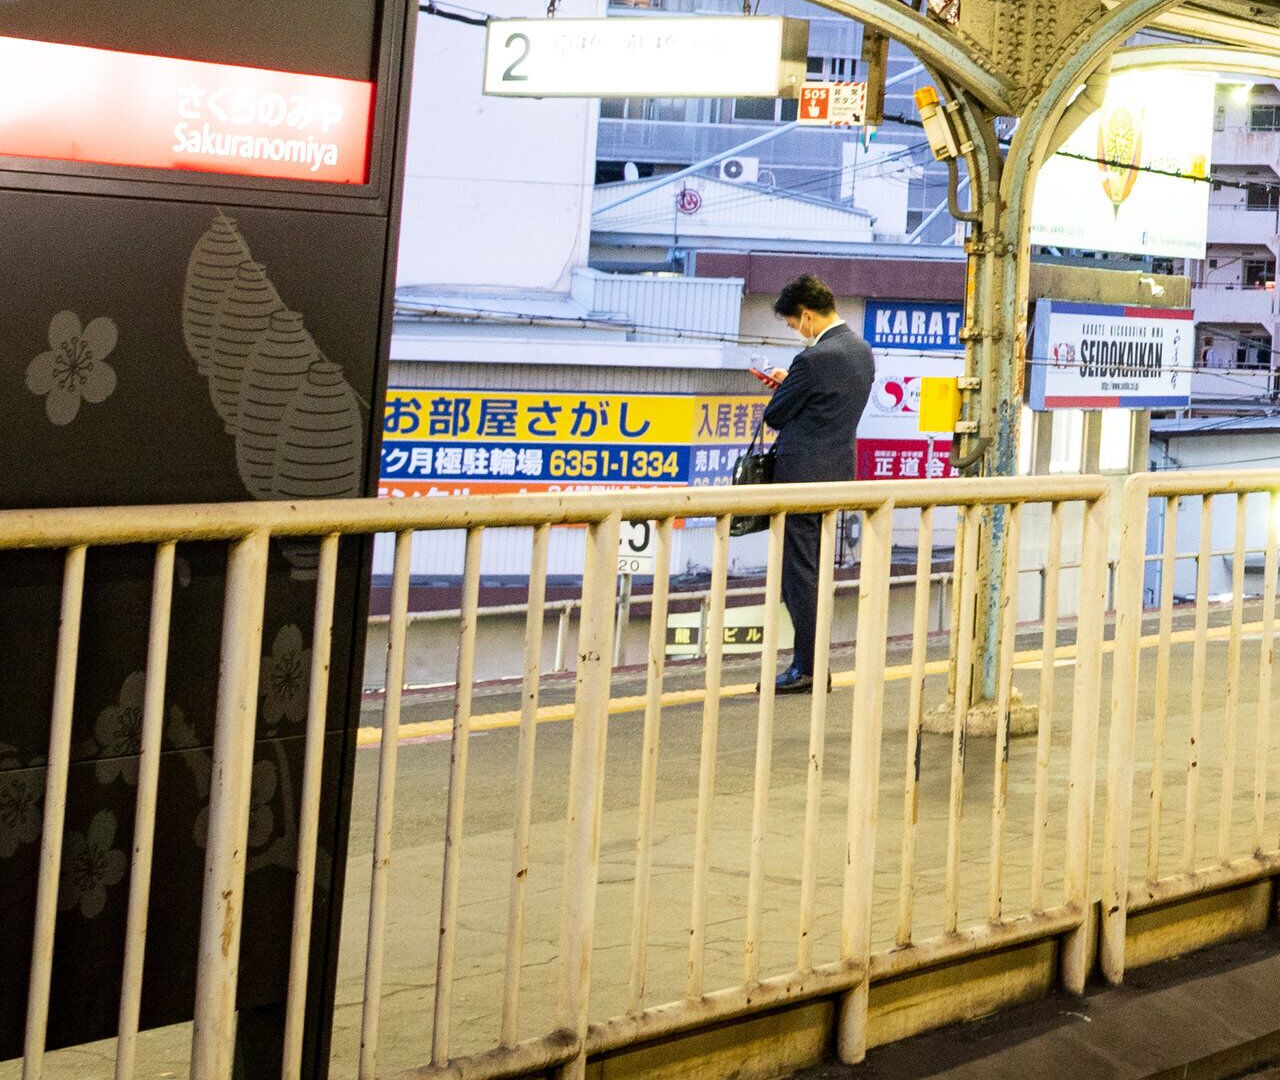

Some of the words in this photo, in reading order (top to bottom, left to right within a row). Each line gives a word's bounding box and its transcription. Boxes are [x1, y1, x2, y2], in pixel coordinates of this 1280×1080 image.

[501, 32, 531, 82] 2
[176, 83, 343, 133] さくらのみや
[804, 89, 826, 100] SOS
[172, 121, 338, 172] Sakuranomiya
[875, 309, 960, 335] KARAT
[1079, 339, 1164, 378] SEIDOKAIKAN
[384, 397, 651, 438] お部屋さがし
[550, 449, 680, 478] 6351-1334
